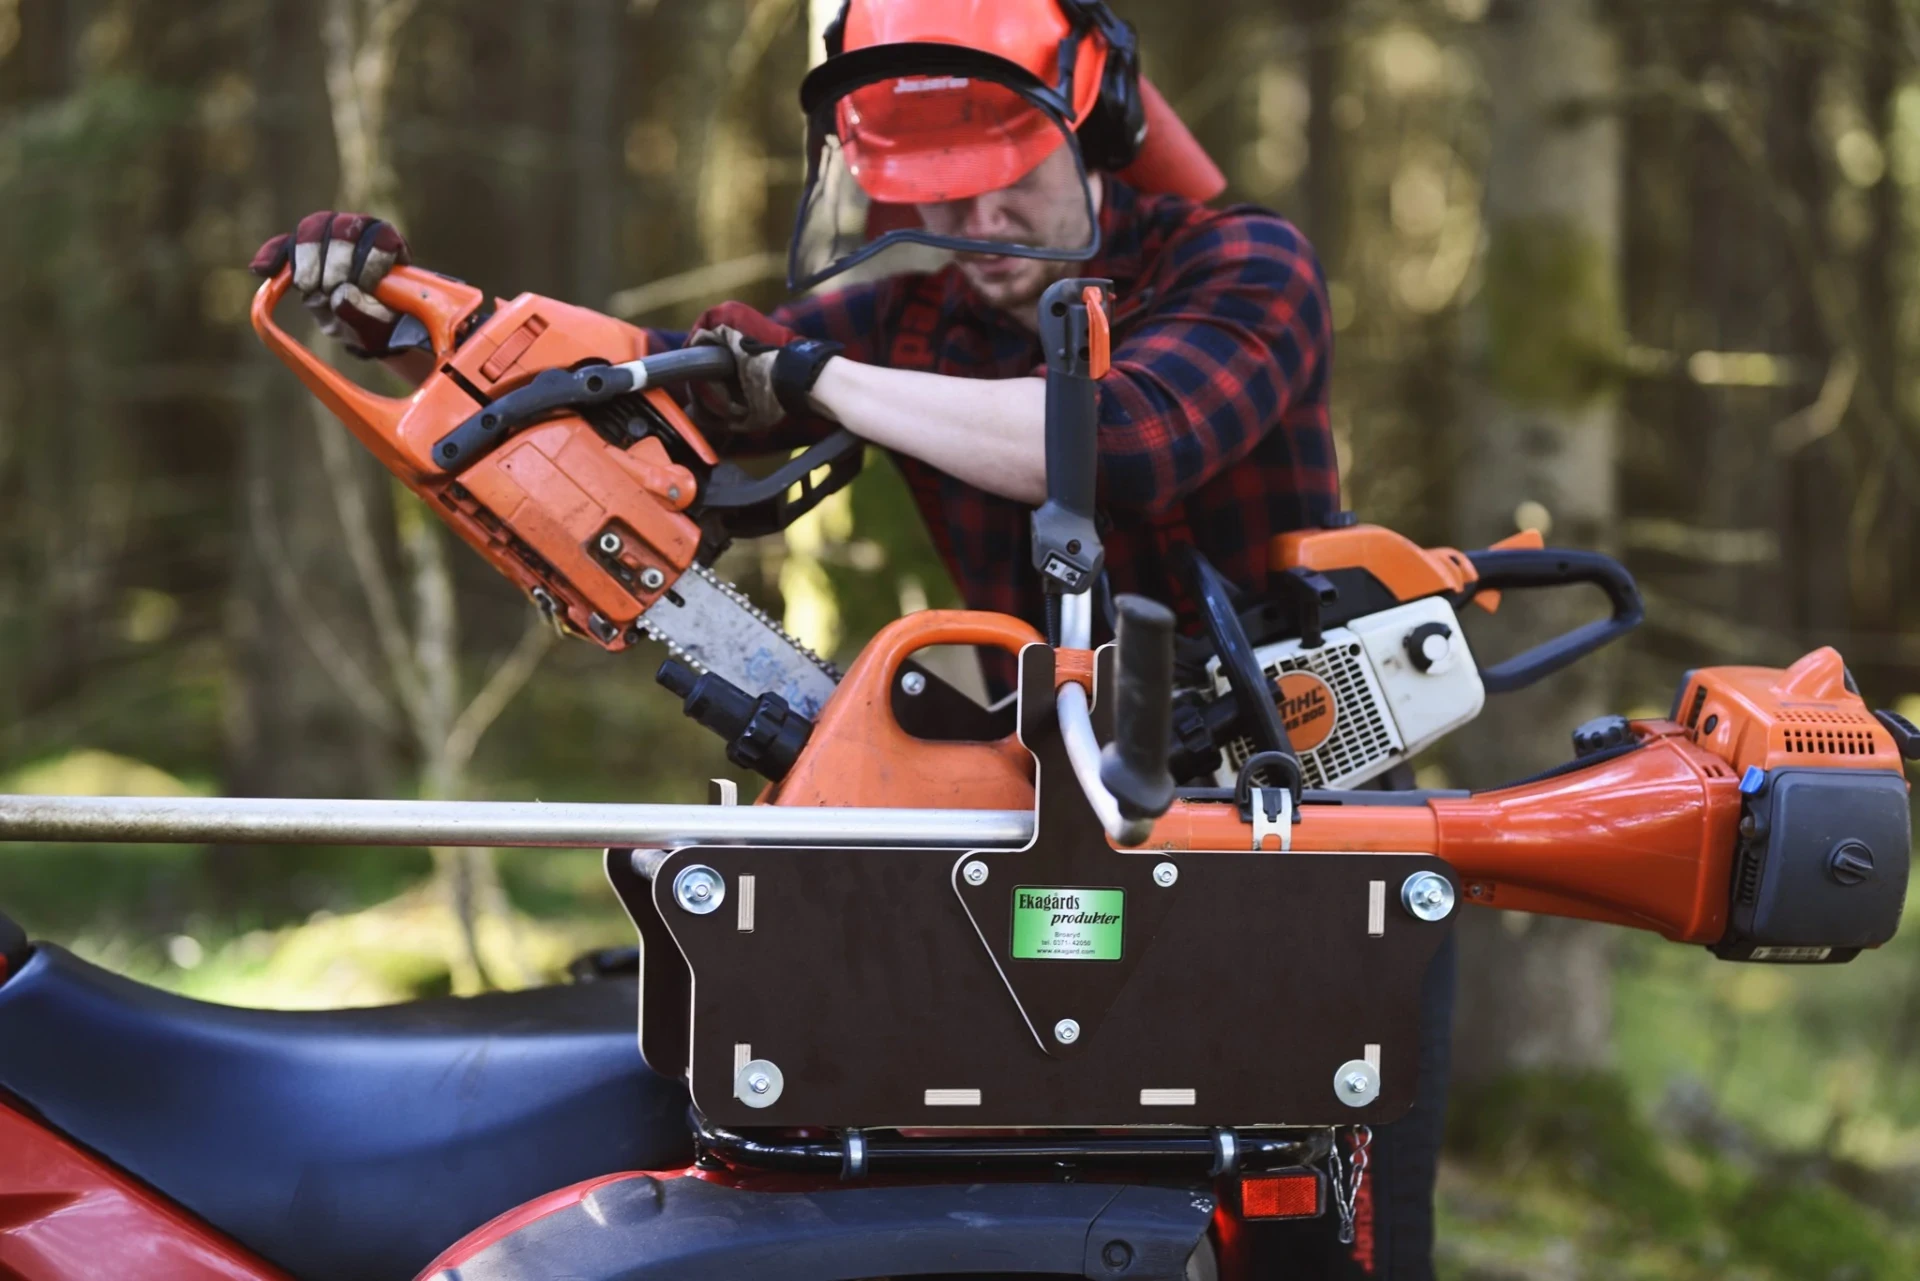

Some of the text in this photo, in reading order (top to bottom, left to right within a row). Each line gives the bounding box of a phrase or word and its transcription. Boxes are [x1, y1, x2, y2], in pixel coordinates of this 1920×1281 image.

[1277, 687, 1325, 719] TIHL
[1019, 892, 1080, 911] Ekagårds
[1050, 912, 1120, 926] produkter
